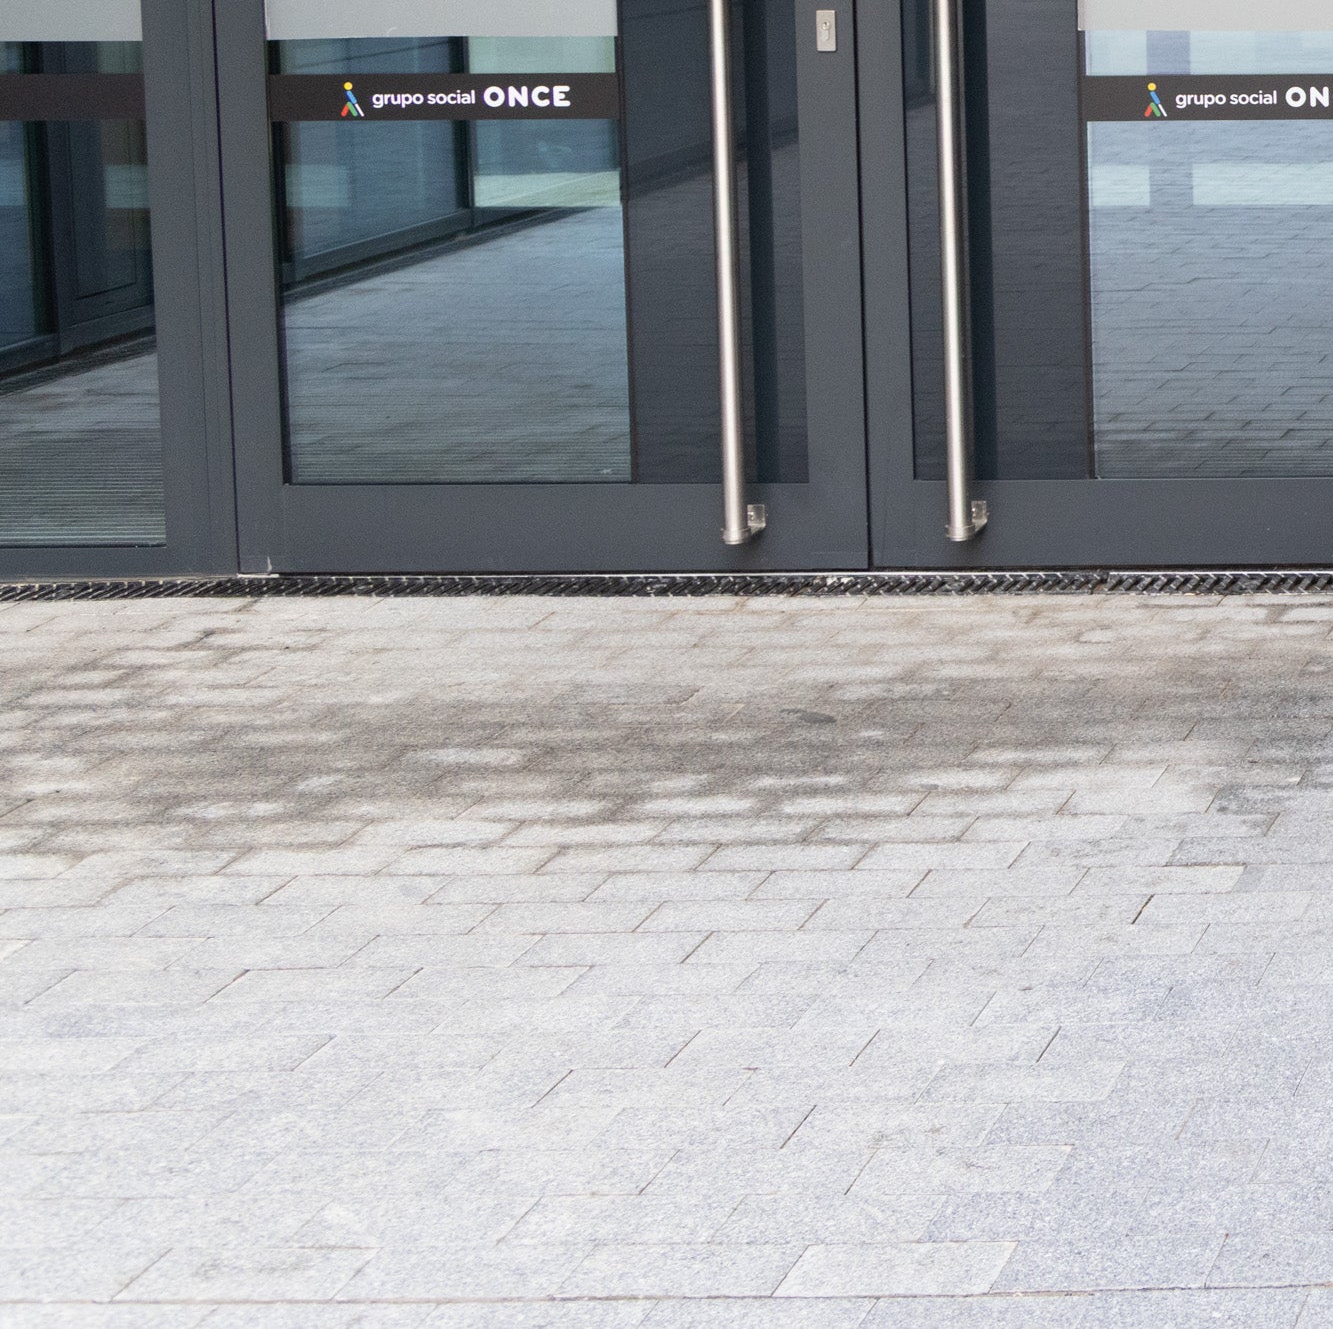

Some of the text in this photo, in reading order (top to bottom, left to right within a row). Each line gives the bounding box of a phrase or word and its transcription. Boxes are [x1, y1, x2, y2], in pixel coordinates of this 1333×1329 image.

[371, 85, 571, 109] grupo social ONCE
[1175, 92, 1228, 110] grupo
[1230, 89, 1278, 106] social
